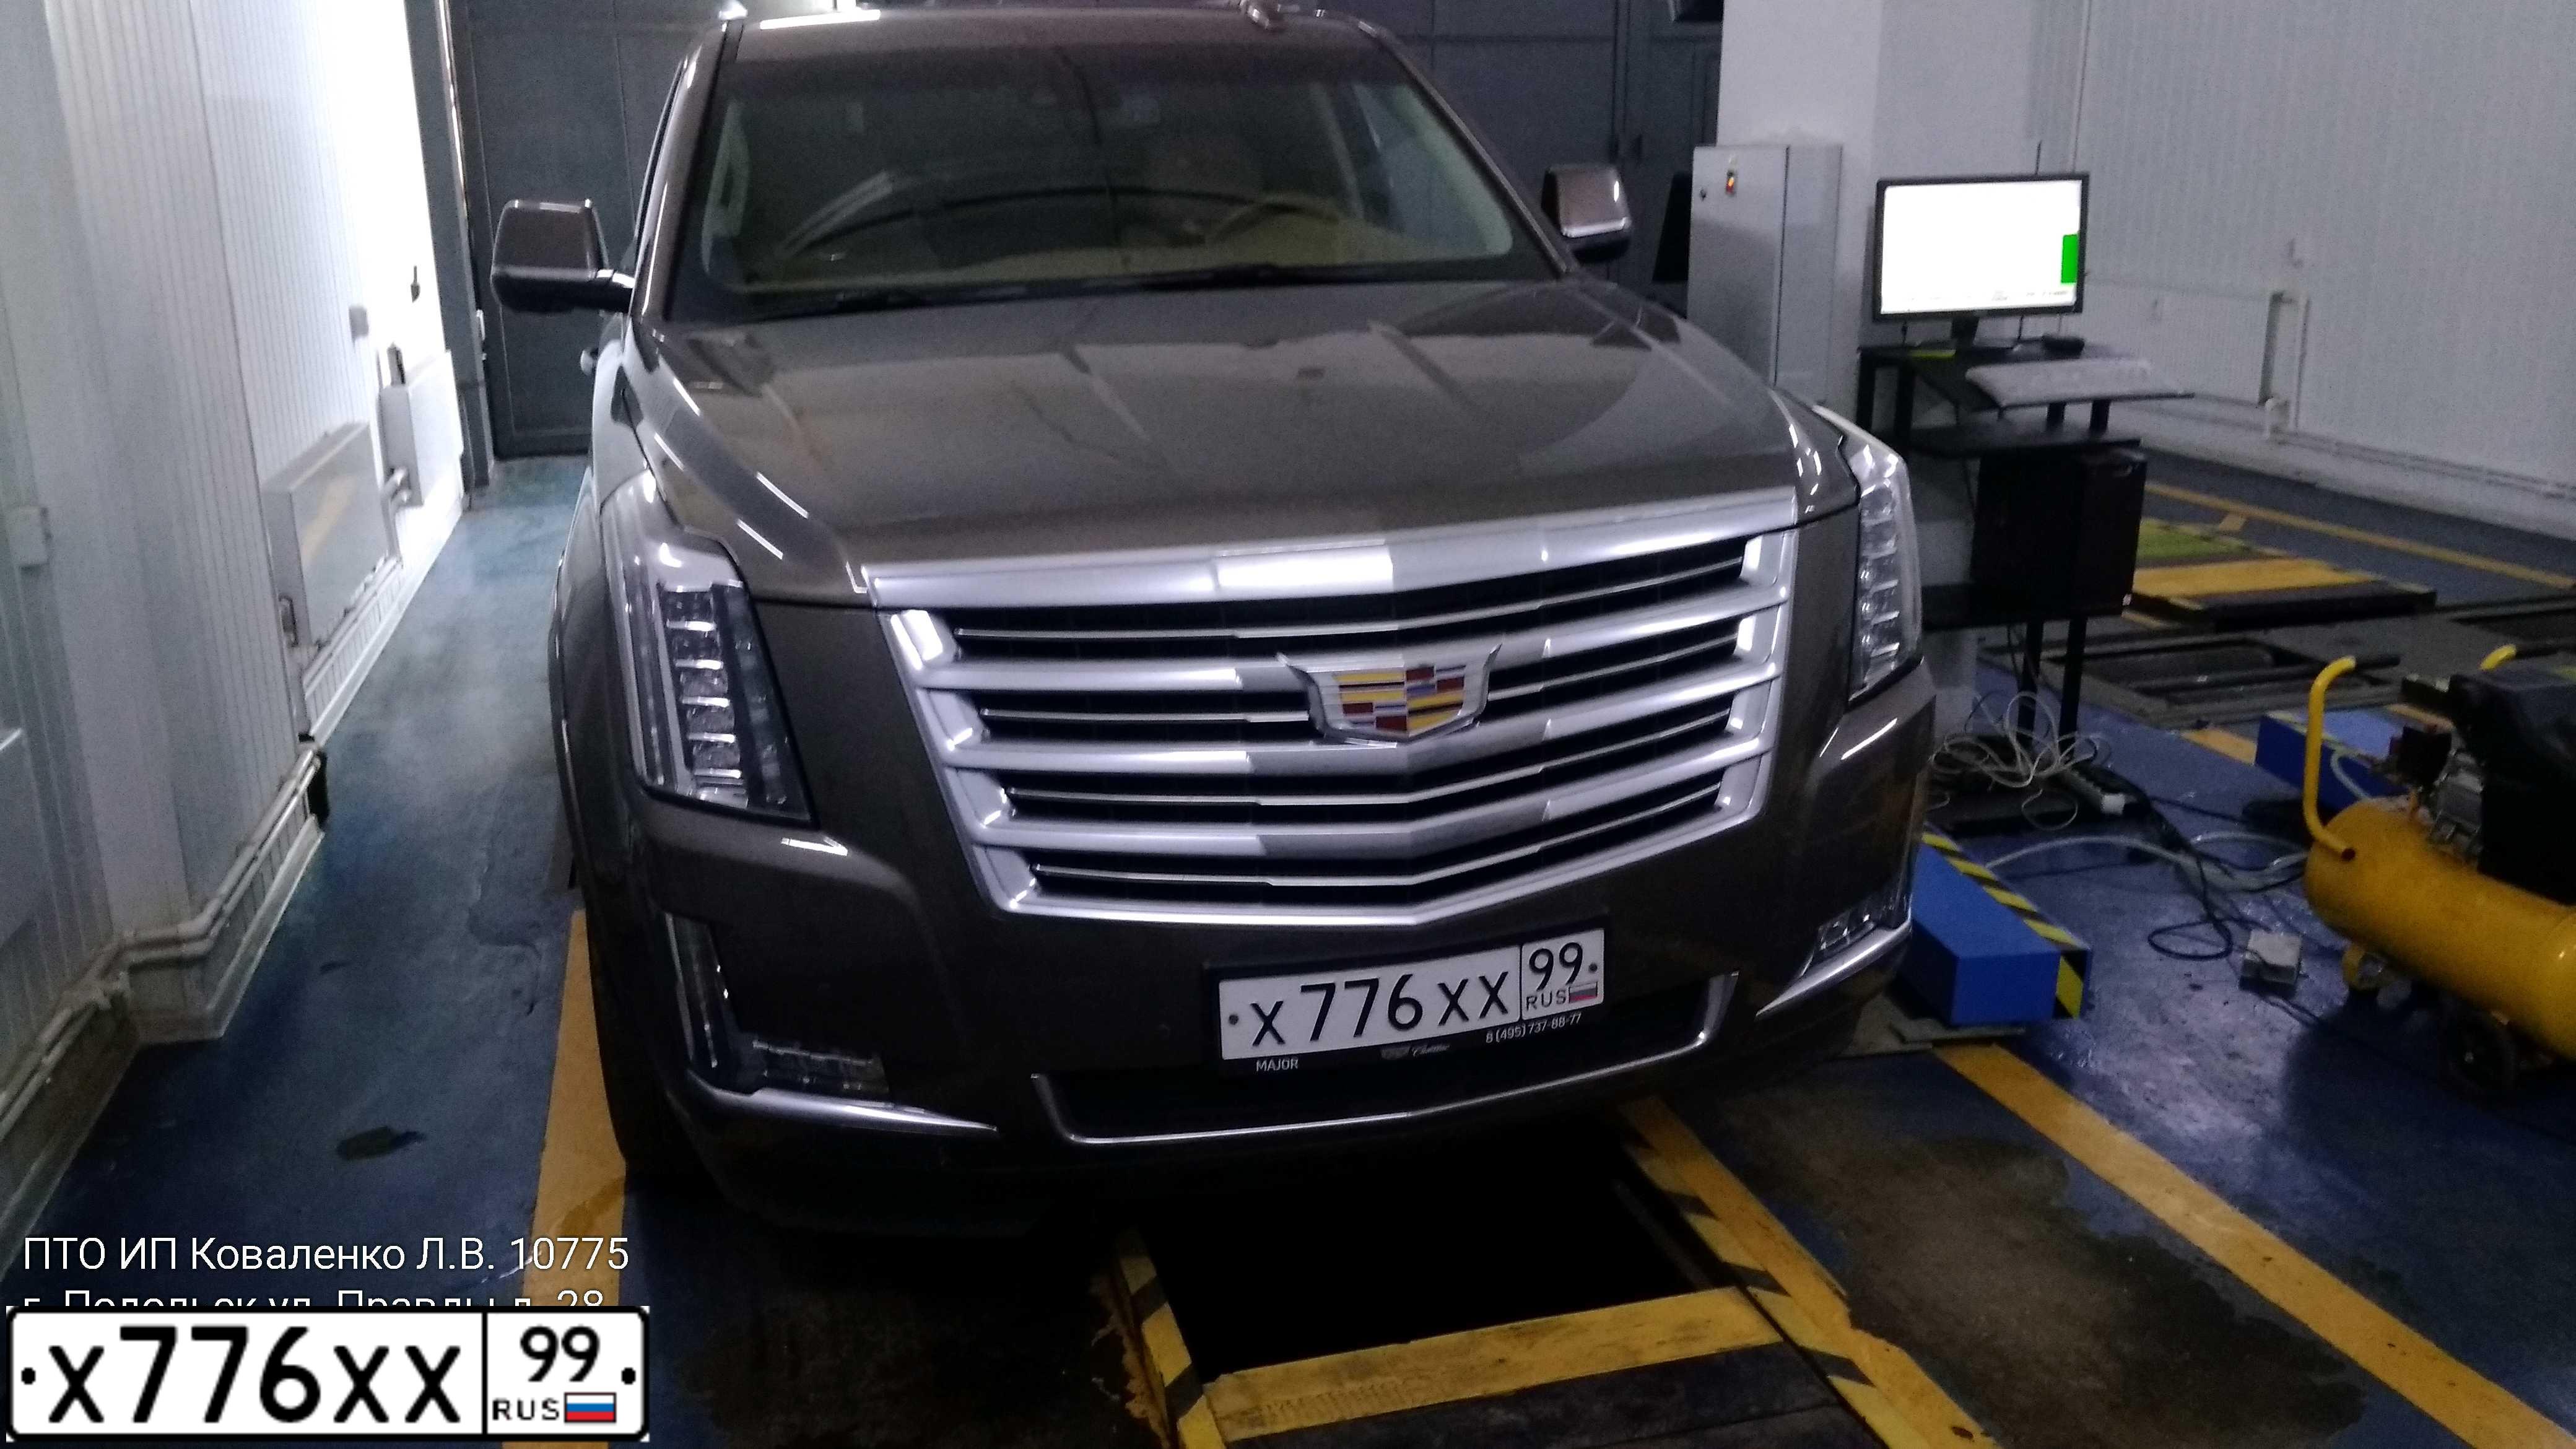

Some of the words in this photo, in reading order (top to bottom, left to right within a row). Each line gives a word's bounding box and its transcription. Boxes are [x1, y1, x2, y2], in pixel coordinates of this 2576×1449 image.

[1529, 942, 1583, 991] 99
[1526, 990, 1567, 1011] RUS
[1486, 1031, 1494, 1043] 8
[1256, 1058, 1299, 1072] MAJOR
